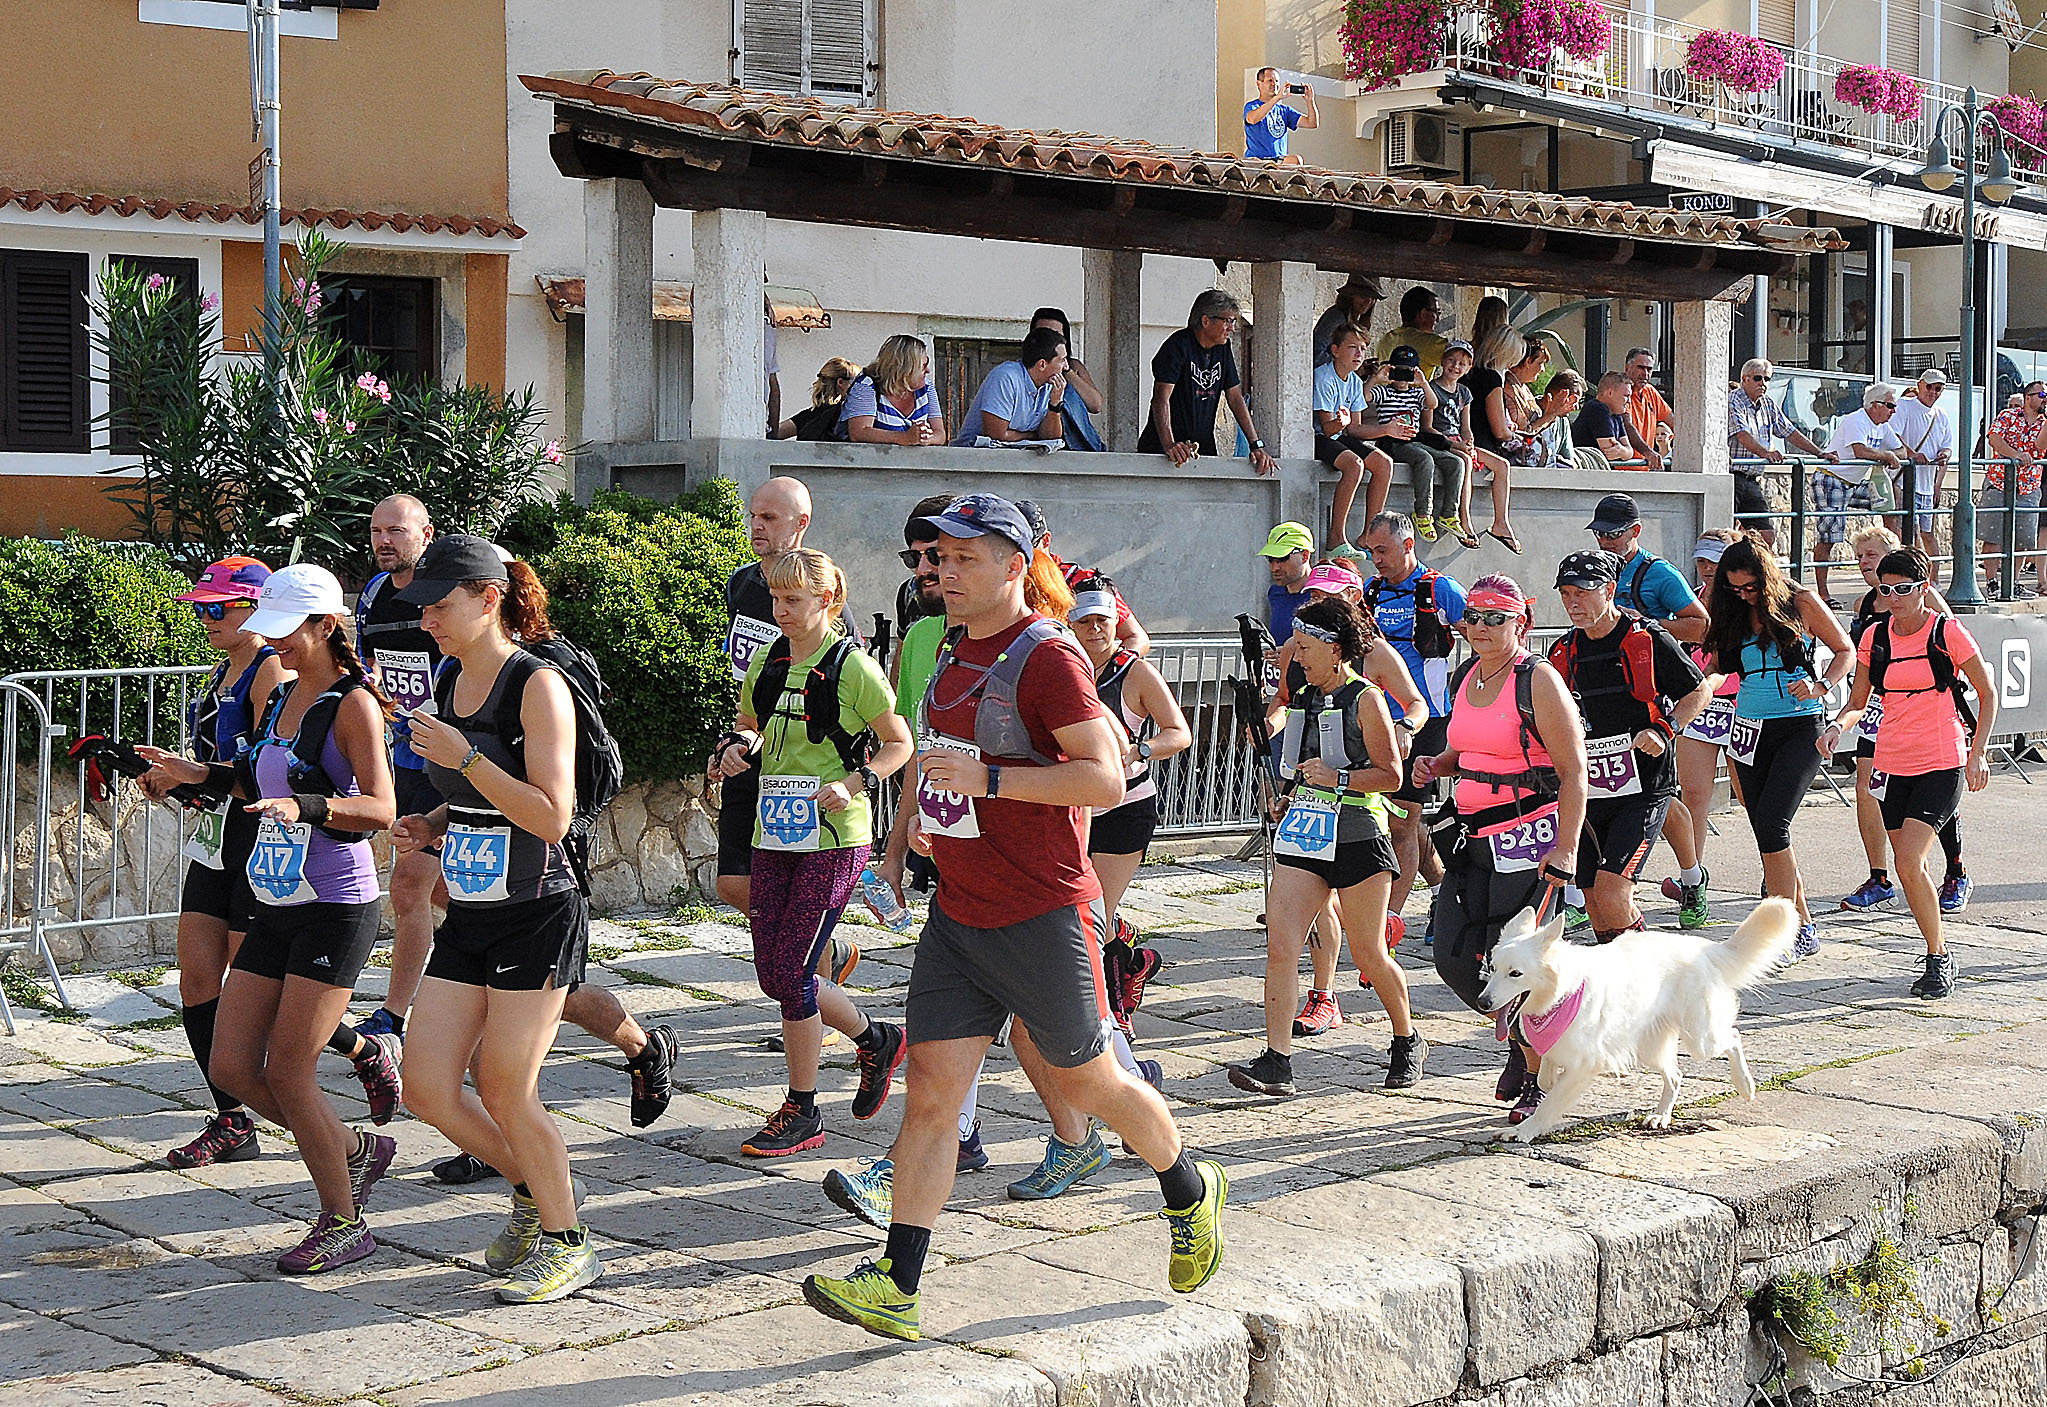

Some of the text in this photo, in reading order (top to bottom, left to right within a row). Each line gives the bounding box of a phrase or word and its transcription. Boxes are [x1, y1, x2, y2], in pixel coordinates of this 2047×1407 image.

[734, 637, 759, 662] 57
[386, 670, 425, 696] 556
[1266, 663, 1281, 680] 56
[1693, 711, 1728, 730] 564
[1732, 724, 1753, 746] 511
[1588, 755, 1626, 779] 513
[765, 798, 810, 824] 249
[1286, 810, 1326, 837] 271
[1500, 818, 1554, 850] 528
[254, 845, 293, 877] 217
[446, 834, 497, 870] 244
